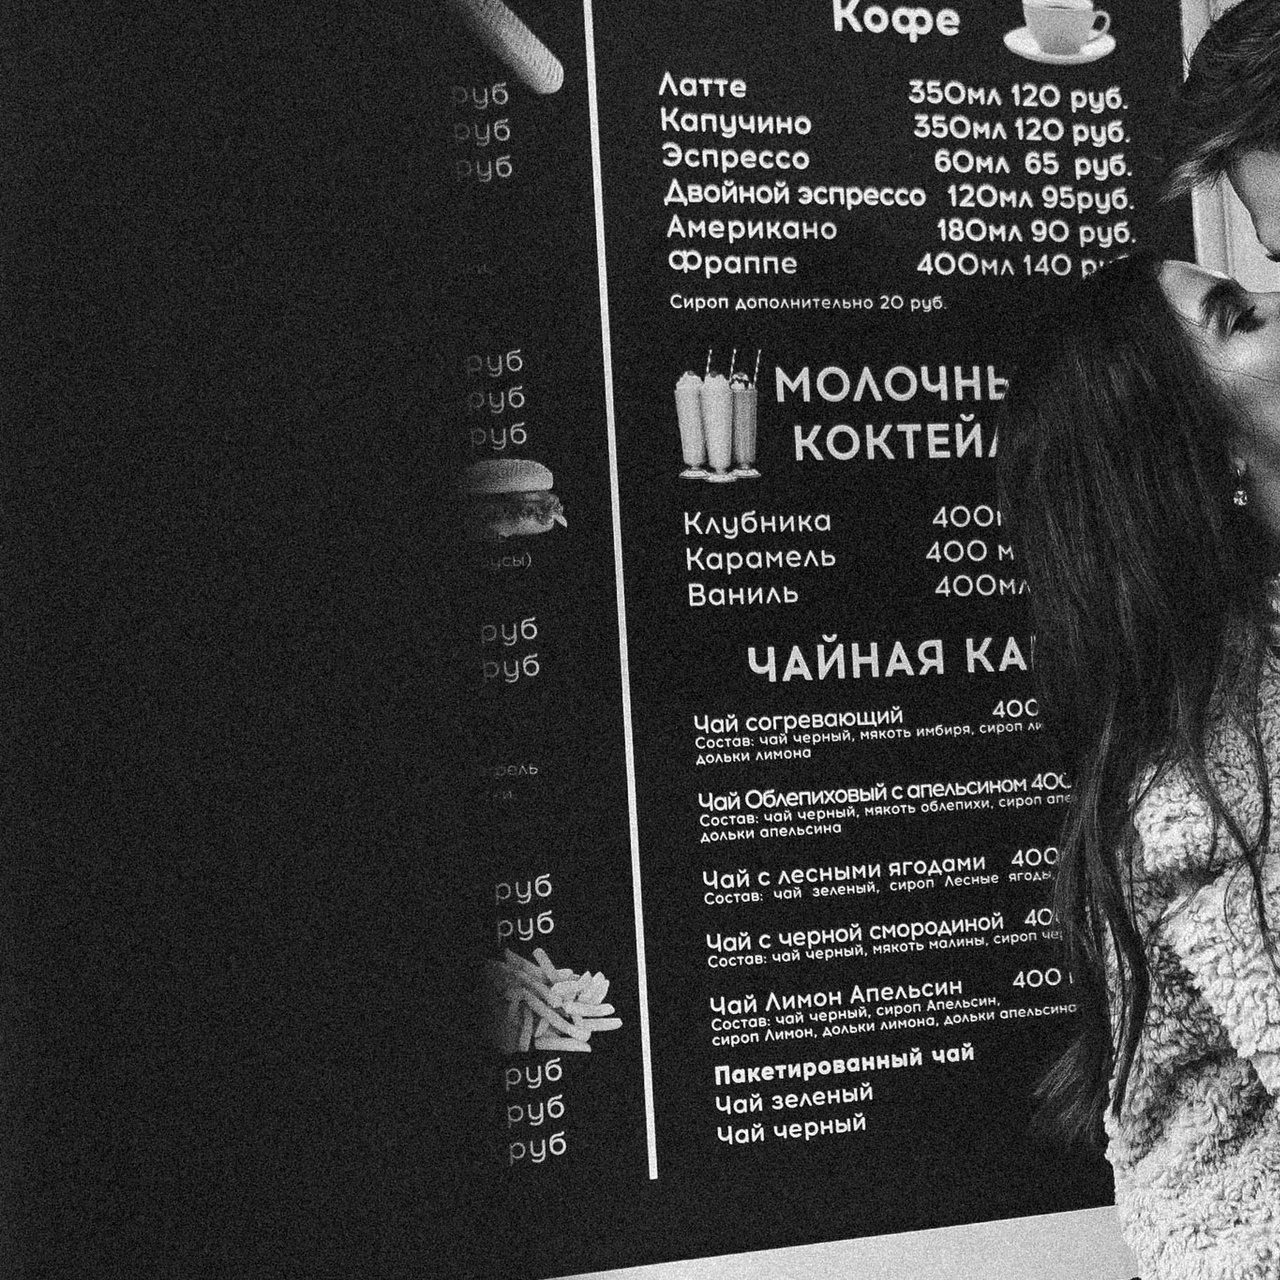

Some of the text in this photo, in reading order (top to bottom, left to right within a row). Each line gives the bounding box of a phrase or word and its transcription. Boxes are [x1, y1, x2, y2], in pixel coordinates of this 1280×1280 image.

[658, 71, 1128, 114] Латте 350мл 120 руб.
[660, 106, 1130, 148] Капучино 350мл 120 руб.
[662, 141, 1132, 181] Эспрессо 60мл 65 руб.
[663, 178, 1134, 215] Двойной эспрессо 120мл 95руб.
[667, 214, 1136, 248] Американо 180мл 90 руб.
[668, 249, 797, 279] Фраппе
[917, 251, 1014, 276] 400мл
[1023, 253, 1072, 276] 140
[670, 293, 947, 312] Сироп дополнительно 20 руб.
[684, 505, 1002, 539] Клубника 400
[686, 547, 836, 575] Карамель
[926, 539, 987, 563] 400
[688, 583, 798, 607] Ваниль
[748, 633, 1036, 682] ЧАЙНАЯ КА
[694, 714, 738, 734] Чай
[746, 706, 904, 732] согревающий
[695, 736, 754, 749] Состав:
[759, 732, 788, 746] чай
[793, 730, 855, 745] черный,
[860, 729, 911, 740] мякоть
[916, 724, 974, 737] имбиря,
[979, 722, 1023, 734] сироп
[696, 748, 811, 766] дольки лимона
[698, 791, 741, 811] Чай
[745, 782, 887, 809] Облепиховый
[891, 785, 903, 800] с
[907, 778, 1027, 799] апельсином
[699, 814, 759, 827] Состав:
[764, 810, 792, 822] чай
[797, 806, 860, 822] черный,
[864, 804, 916, 816] мякоть
[921, 800, 993, 813] облепихи,
[998, 796, 1042, 808] сироп
[700, 823, 842, 843] дольки апельсина
[703, 868, 750, 889] Чай
[758, 871, 770, 886] с
[778, 863, 881, 886] лесными
[888, 856, 985, 877] ягодами
[704, 892, 763, 905] Состав:
[773, 886, 802, 899] чай
[812, 881, 880, 897] зеленый,
[889, 879, 934, 892] сироп
[945, 874, 999, 887] Лесные
[706, 931, 751, 952] Чай
[758, 934, 771, 949] с
[778, 923, 862, 949] черной
[869, 912, 1004, 946] смородиной
[707, 954, 767, 968] Состав:
[772, 949, 800, 962] чай
[805, 944, 868, 961] черный,
[873, 942, 924, 954] мякоть
[929, 937, 988, 949] малины,
[993, 932, 1037, 945] сироп
[710, 994, 757, 1016] Чай
[765, 991, 842, 1012] Лимон
[850, 980, 962, 1005] Апельсин
[1012, 968, 1062, 988] 400
[711, 997, 1000, 1031] Состав: чай черный, сироп Апельсин,
[712, 1032, 759, 1047] сироп
[765, 1028, 817, 1041] Лимон,
[822, 1022, 875, 1037] дольки
[880, 1017, 939, 1030] лимона,
[943, 1011, 995, 1026] дольки
[714, 1042, 974, 1086] Пакетированный чай
[715, 1082, 873, 1115] Чай зеленый
[717, 1112, 866, 1145] Чай черный
